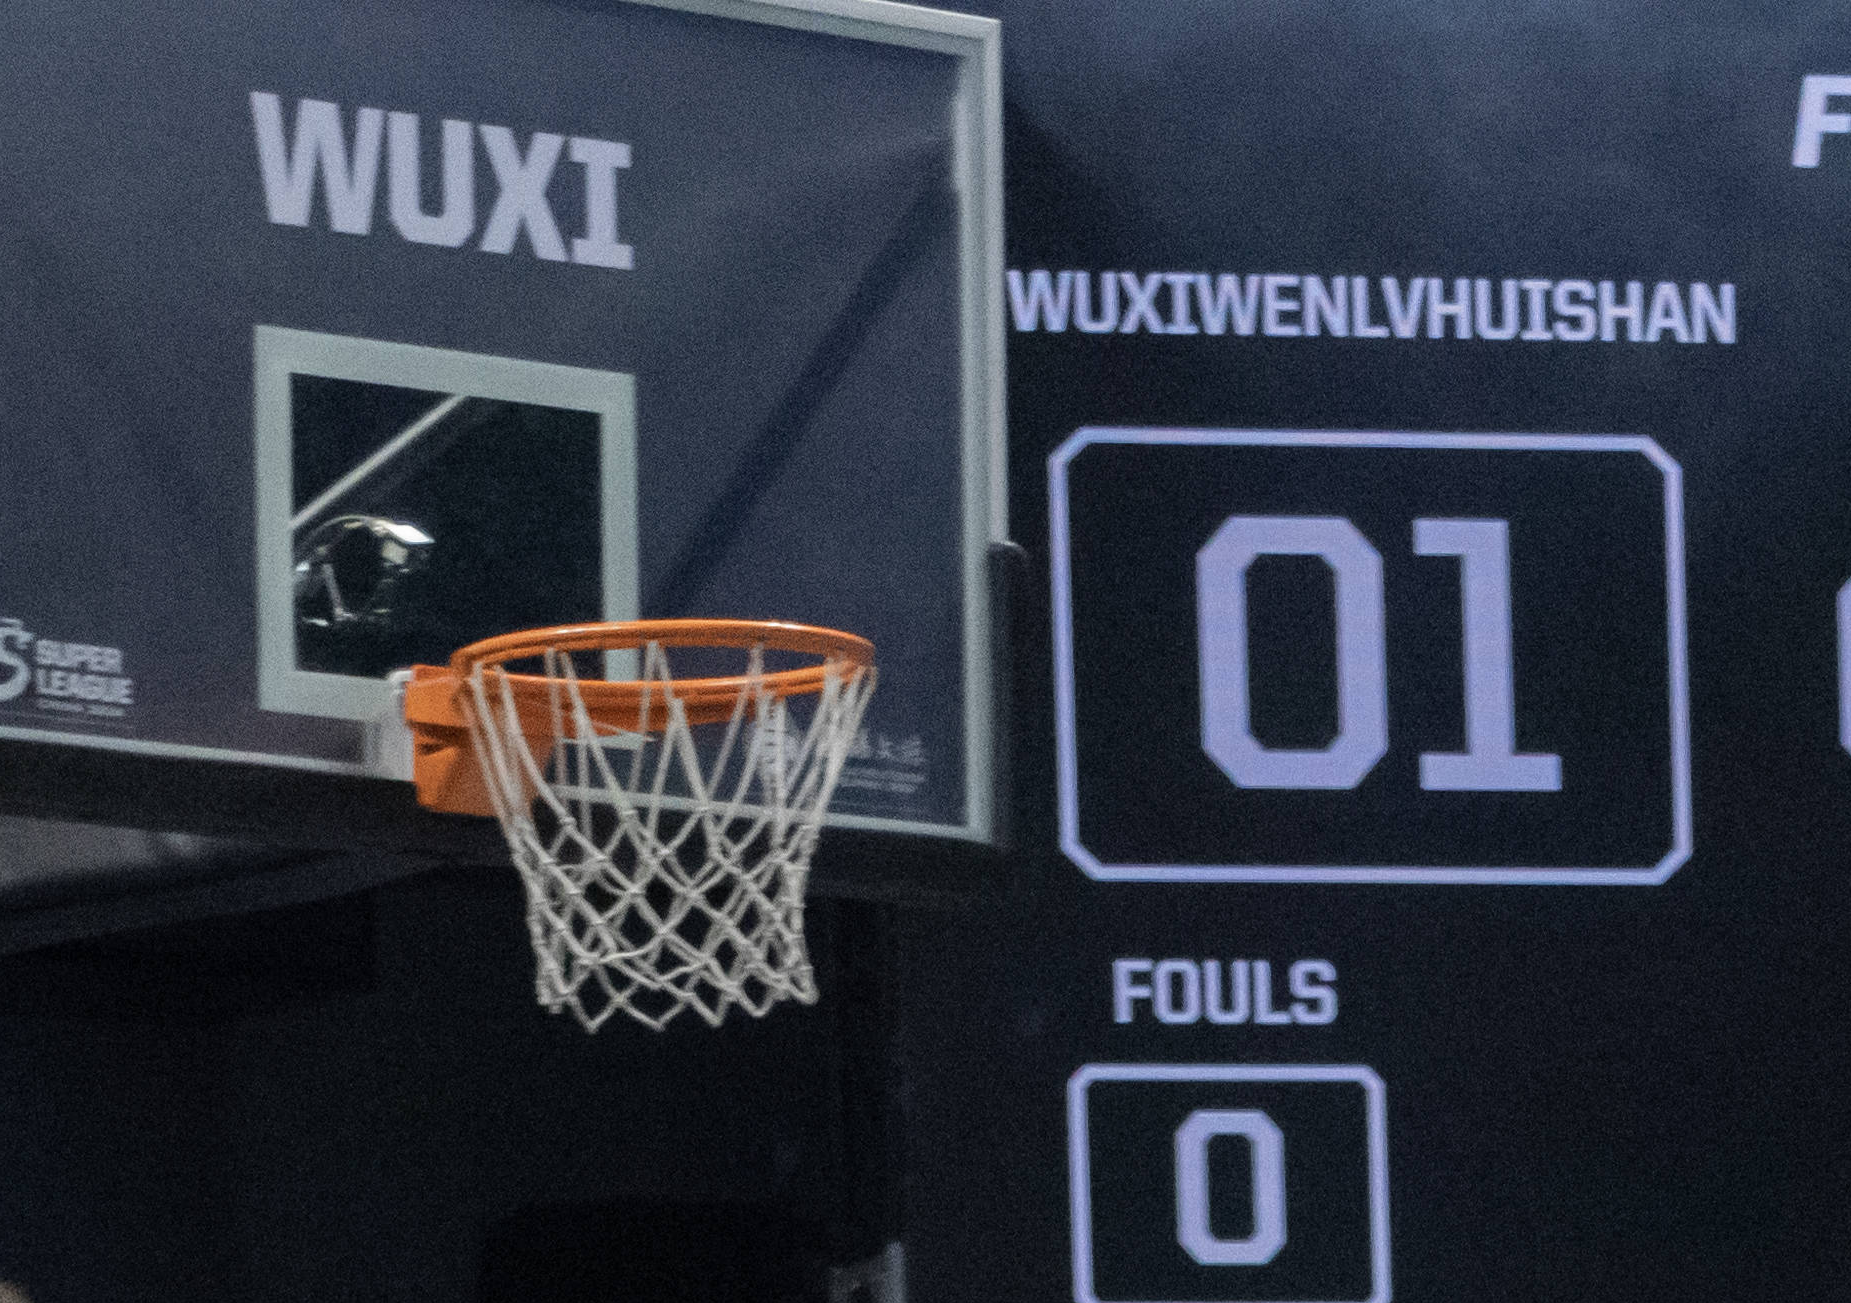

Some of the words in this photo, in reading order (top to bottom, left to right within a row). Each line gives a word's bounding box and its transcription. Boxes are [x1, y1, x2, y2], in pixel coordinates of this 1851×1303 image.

[250, 91, 635, 271] WUXI
[1005, 268, 1736, 344] WUXIWENLVHUISHAN
[1194, 514, 1563, 792] 01
[1112, 958, 1339, 1026] FOULS
[1174, 1108, 1288, 1266] 0
